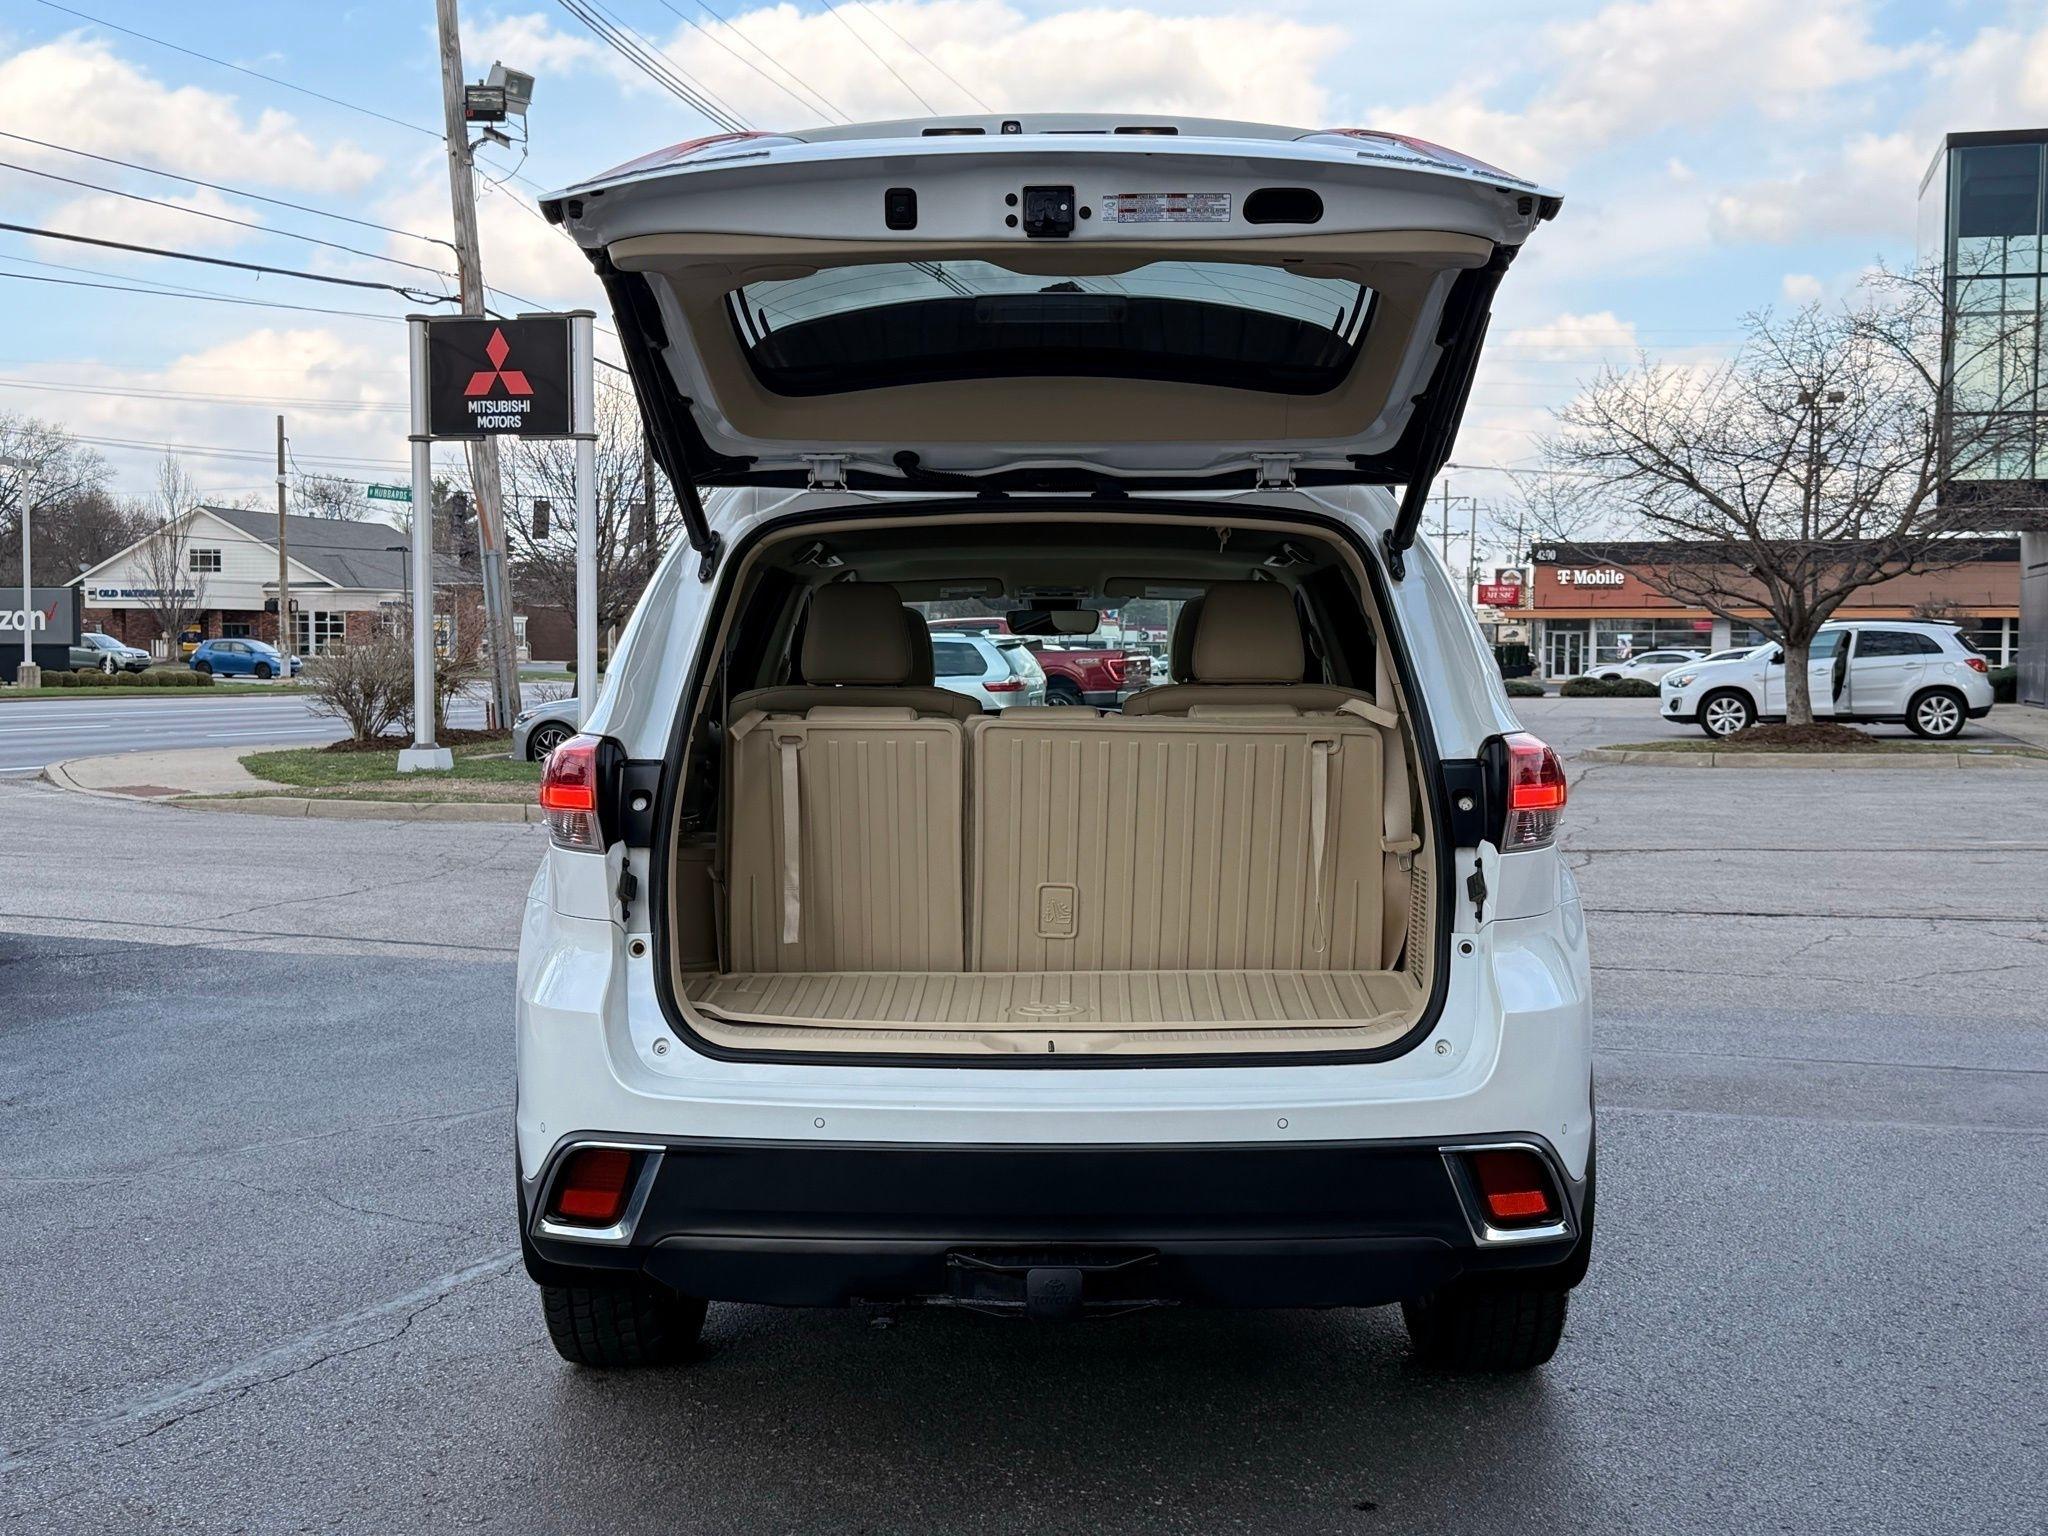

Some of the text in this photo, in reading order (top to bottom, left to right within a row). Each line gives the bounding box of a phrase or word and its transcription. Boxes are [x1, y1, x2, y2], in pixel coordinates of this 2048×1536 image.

[468, 400, 530, 413] MITSUBISHI
[477, 415, 522, 428] MOTORS
[1573, 569, 1625, 585] Mobile
[98, 589, 119, 598] OLD
[120, 589, 166, 598] NATIONAL
